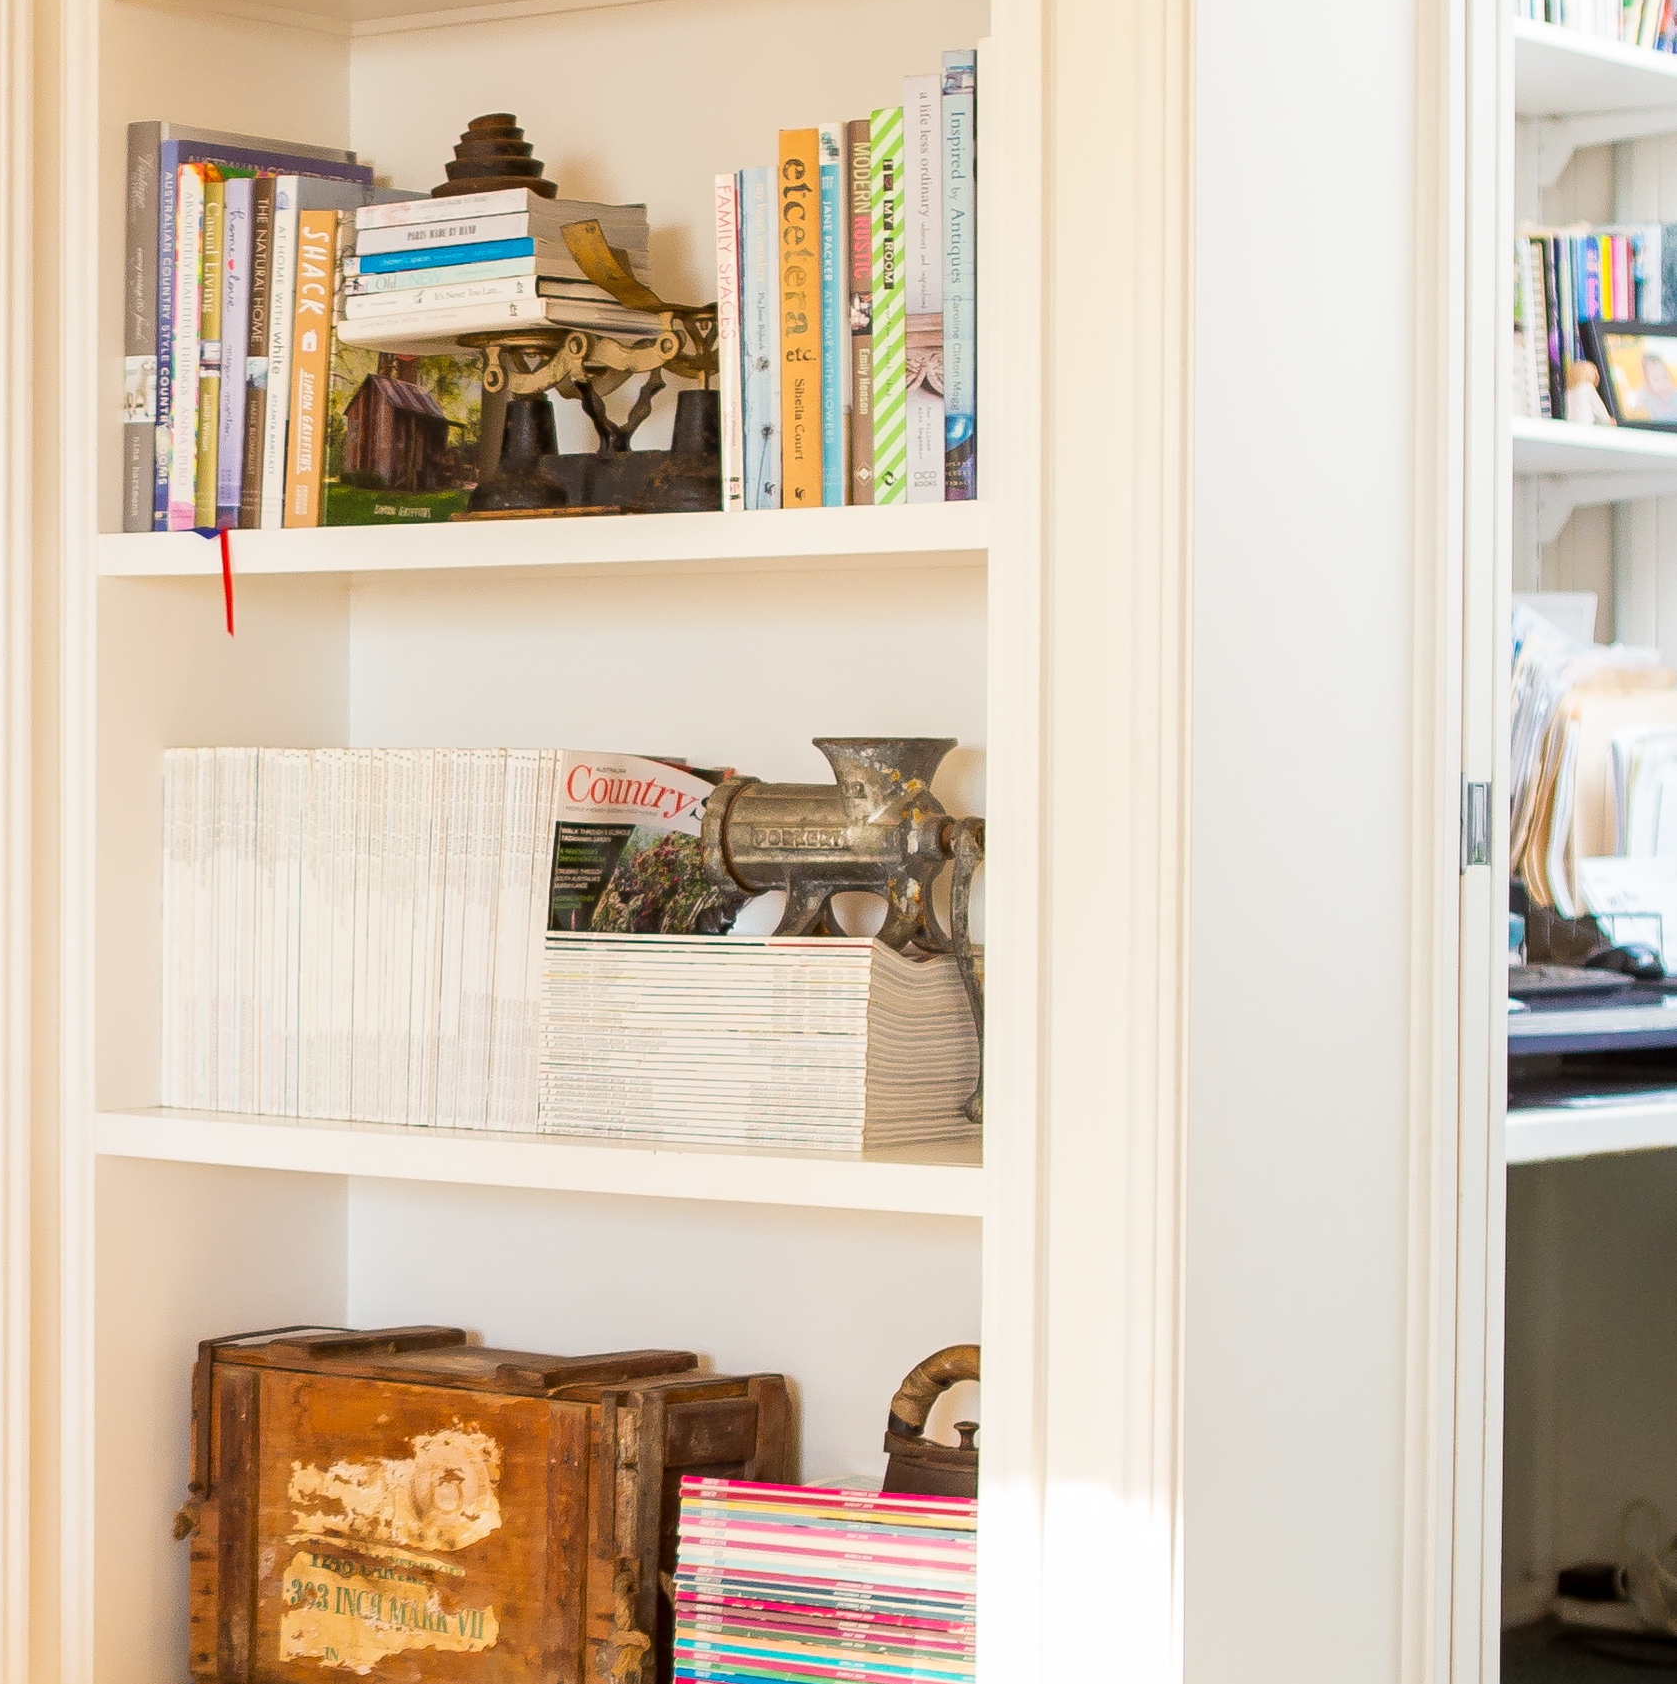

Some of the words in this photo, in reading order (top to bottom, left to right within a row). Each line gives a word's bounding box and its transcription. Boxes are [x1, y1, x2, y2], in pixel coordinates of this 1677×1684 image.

[920, 92, 929, 100] a
[920, 103, 932, 126] life
[920, 130, 932, 154] less
[949, 111, 967, 180] Inspired
[853, 142, 871, 214] MODERN
[917, 158, 932, 217] ordinary
[950, 187, 963, 201] by
[162, 171, 174, 252] AUSTRALIAN
[182, 192, 194, 268] ABSOLUTELY
[204, 202, 220, 255] Casual
[255, 199, 267, 224] THE
[717, 184, 733, 253] FAMILY
[823, 201, 834, 233] JANE
[227, 208, 244, 257] home
[277, 225, 287, 242] AT
[407, 230, 427, 241] PARIS
[429, 228, 446, 239] MADE
[448, 226, 456, 237] BY
[458, 225, 477, 236] HAND
[783, 157, 815, 338] etcetera
[854, 216, 872, 280] RUSTIC
[949, 207, 967, 284] Antiques
[253, 229, 267, 295] NATURAL
[275, 246, 286, 285] HOME
[299, 227, 329, 316] SHACK
[823, 236, 834, 282] PACKER
[161, 257, 172, 320] COUNTRY
[202, 270, 219, 313] Living
[227, 275, 241, 312] love
[375, 276, 397, 291] Old
[409, 271, 442, 287] NEW
[824, 290, 834, 303] AT
[181, 273, 193, 345] BEAUTIFUL
[252, 300, 264, 344] HOME
[273, 293, 285, 325] WITH
[720, 264, 735, 341] SPACES
[952, 295, 963, 340] Caroline
[160, 325, 171, 362] STYLE
[824, 308, 834, 346] HOME
[180, 346, 192, 396] THINGS
[271, 332, 284, 375] white
[785, 345, 817, 363] etc.
[824, 350, 835, 383] WITH
[858, 348, 871, 373] Emily
[952, 343, 963, 378] Clifton
[159, 367, 170, 428] COUNTRY
[201, 394, 212, 422] Judith
[301, 370, 316, 410] SIMON
[794, 378, 807, 420] Sibella
[859, 377, 870, 415] Henson
[950, 381, 963, 410] Mogg
[179, 406, 191, 446] ANNA
[824, 387, 835, 444] FLOWERS
[131, 436, 141, 461] nina
[200, 422, 211, 452] Wilson
[299, 415, 314, 473] GRIFFITHS
[794, 424, 806, 460] Court
[178, 448, 190, 487] SPIRO
[566, 764, 699, 819] Country
[459, 1609, 486, 1640] VII
[324, 1647, 340, 1661] IN
